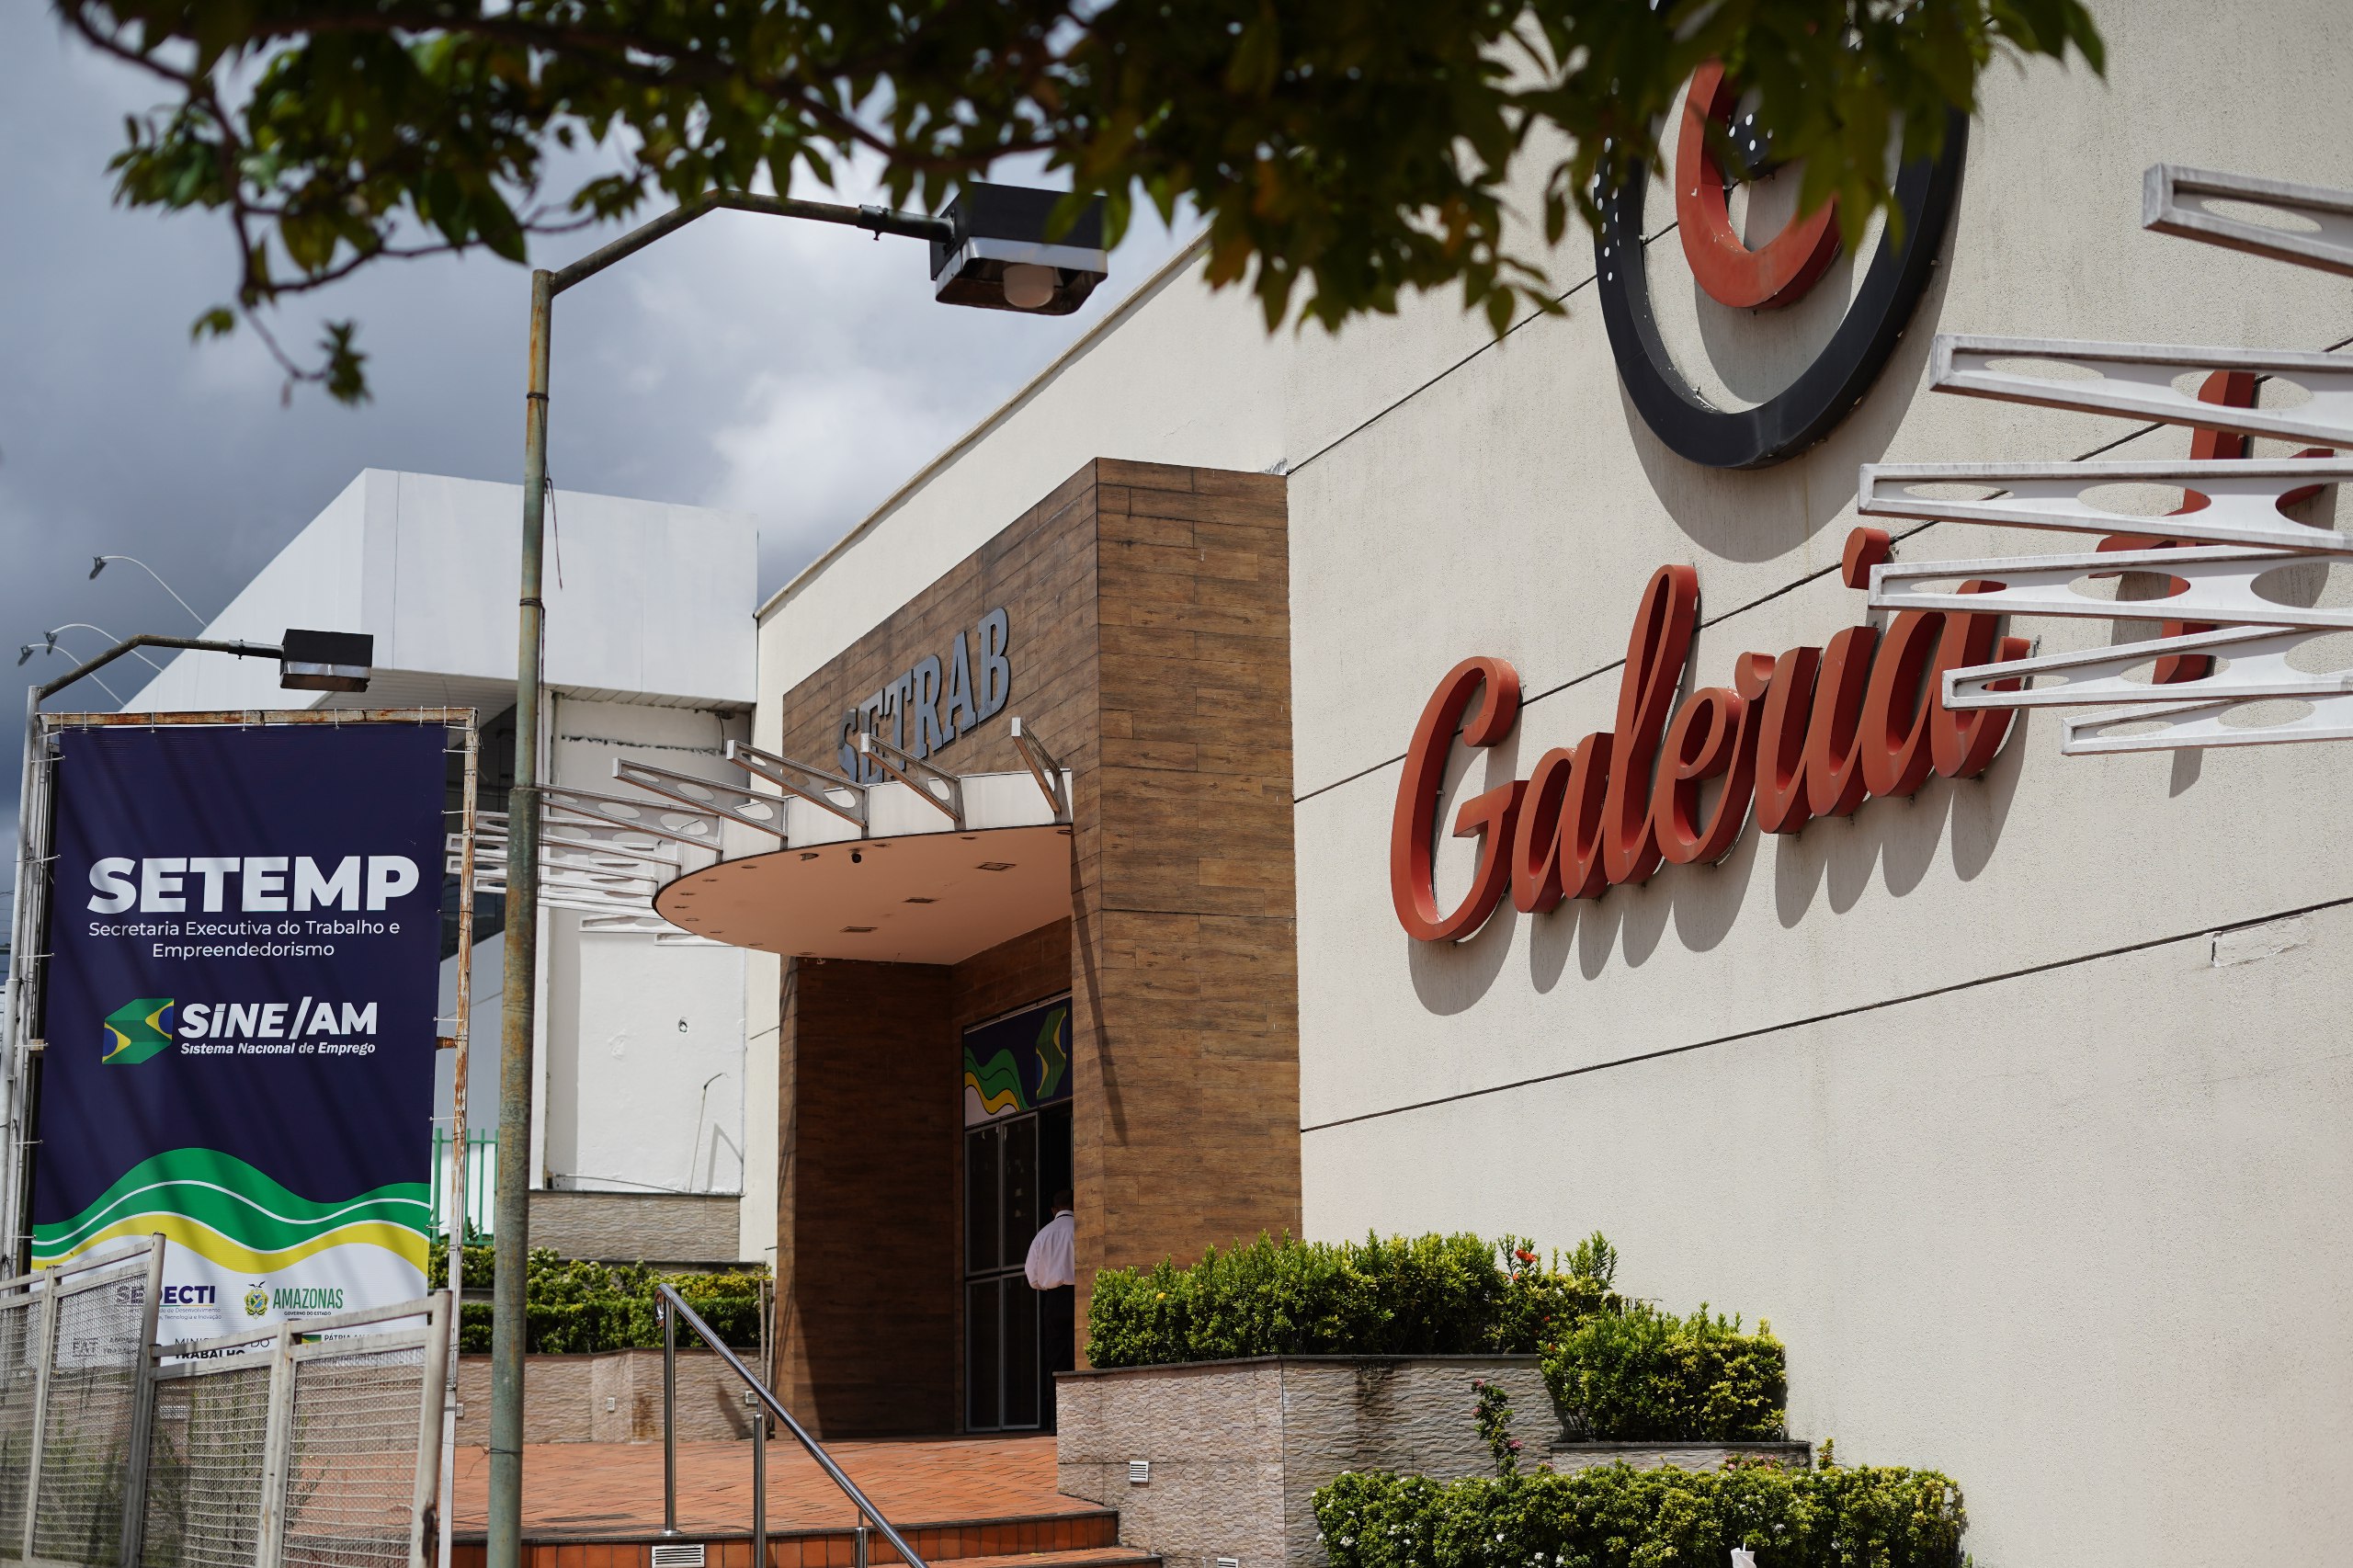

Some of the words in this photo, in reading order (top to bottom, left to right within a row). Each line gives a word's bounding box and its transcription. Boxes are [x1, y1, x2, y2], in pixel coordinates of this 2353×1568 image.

[837, 608, 1010, 783] SETRAB
[1391, 527, 2029, 941] Galeria
[87, 856, 419, 914] SETEMP
[89, 920, 179, 937] Secretaria
[186, 921, 271, 936] Executiva
[278, 920, 301, 935] do
[305, 920, 384, 935] Trabalho
[389, 922, 401, 934] e
[153, 942, 335, 960] Empreendedorismo
[181, 1042, 233, 1054] Sistema
[237, 1042, 295, 1054] Nacional
[299, 1042, 314, 1053] de
[318, 1041, 376, 1056] Emprego
[273, 1288, 344, 1309] AMAZONAS
